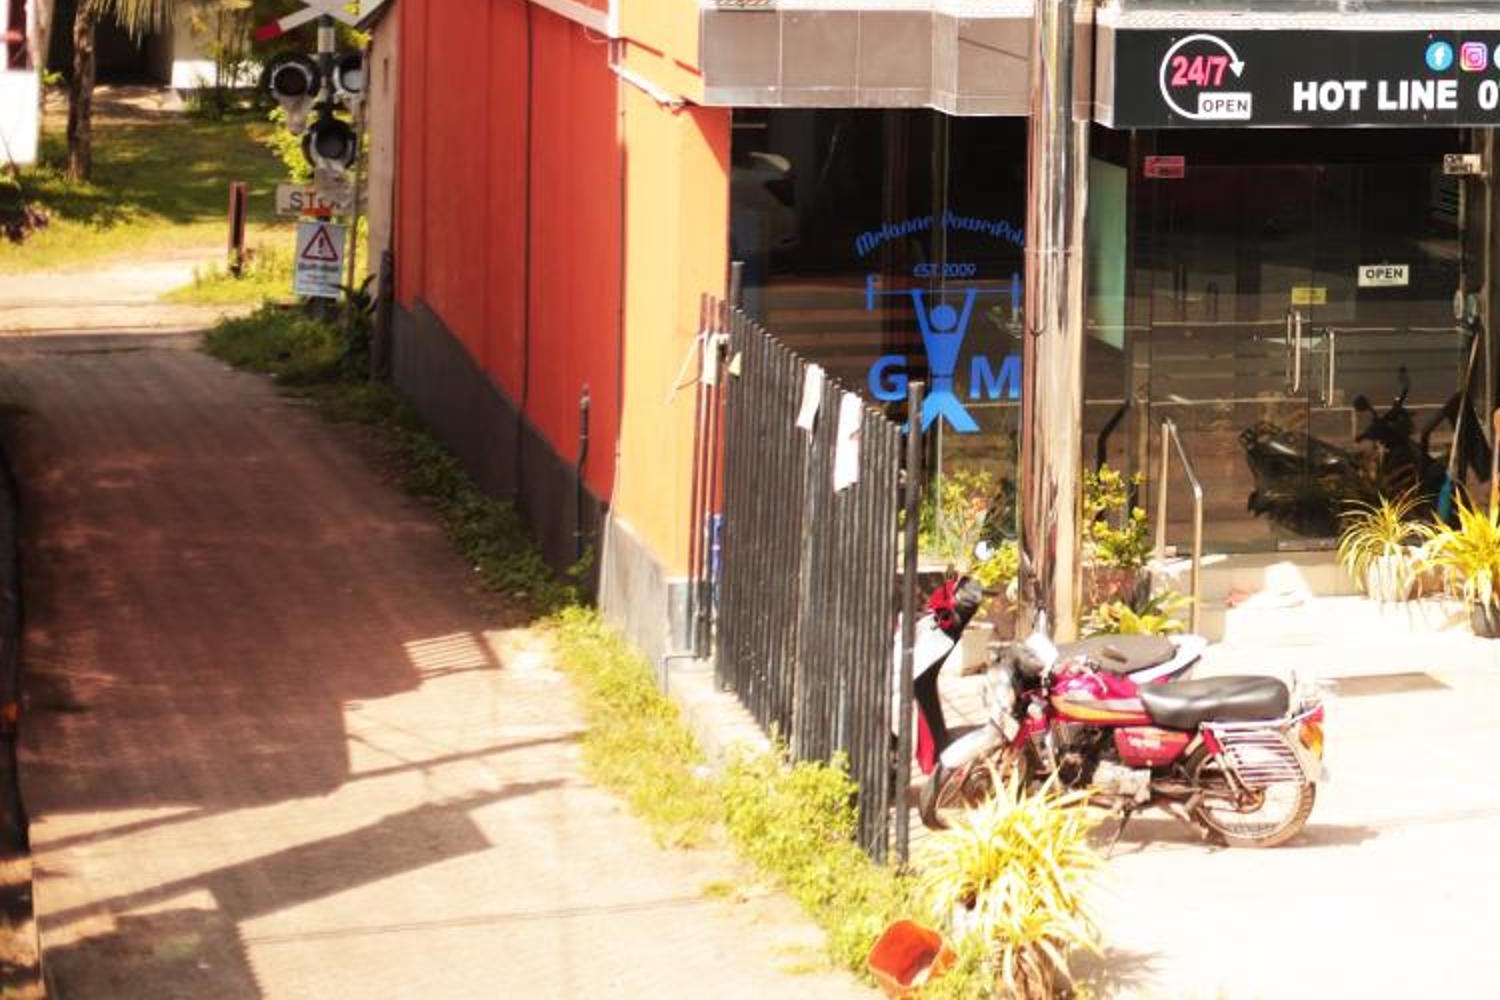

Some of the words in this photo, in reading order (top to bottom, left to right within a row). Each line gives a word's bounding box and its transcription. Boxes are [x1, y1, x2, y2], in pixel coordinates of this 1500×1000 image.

[1171, 55, 1229, 87] 24/7
[1202, 99, 1249, 113] OPEN
[1292, 80, 1368, 112] HOT
[1377, 79, 1459, 111] LINE
[1365, 268, 1403, 279] OPEN
